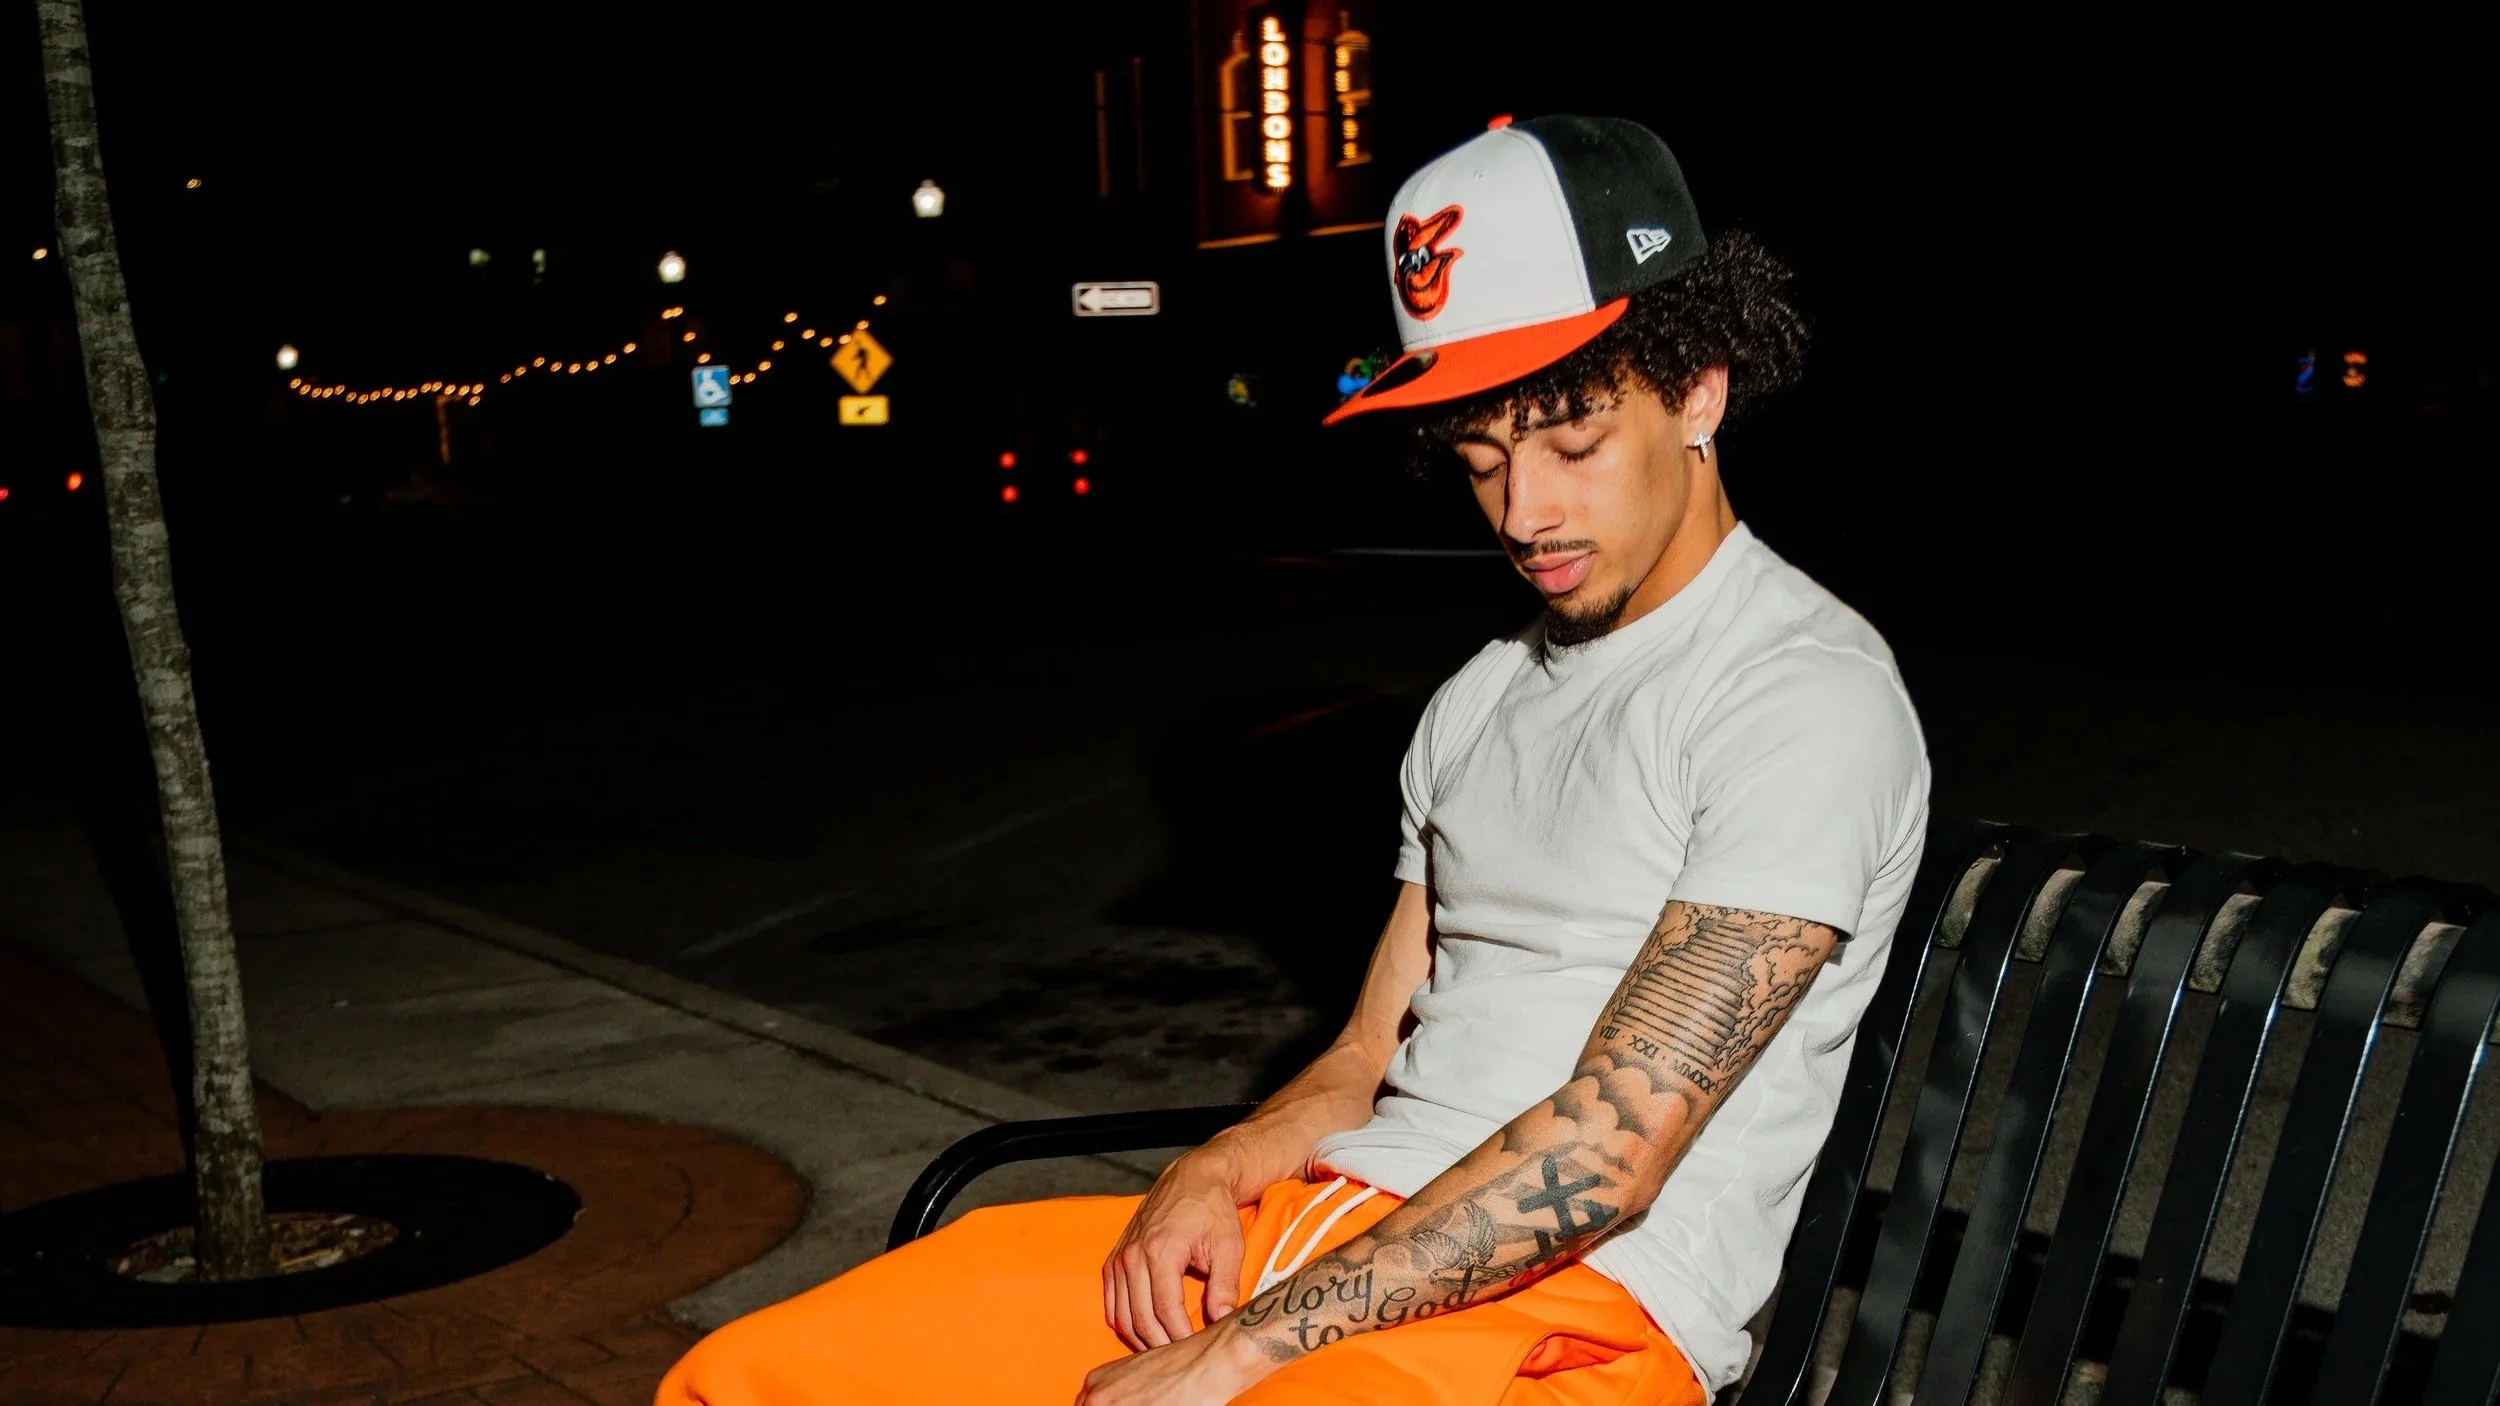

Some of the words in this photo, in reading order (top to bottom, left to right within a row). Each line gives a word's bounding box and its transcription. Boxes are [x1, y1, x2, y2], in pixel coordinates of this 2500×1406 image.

[1626, 1034, 1660, 1061] XXI
[1239, 1266, 1374, 1326] Glory
[1289, 1315, 1345, 1351] to
[1373, 1263, 1477, 1330] God
